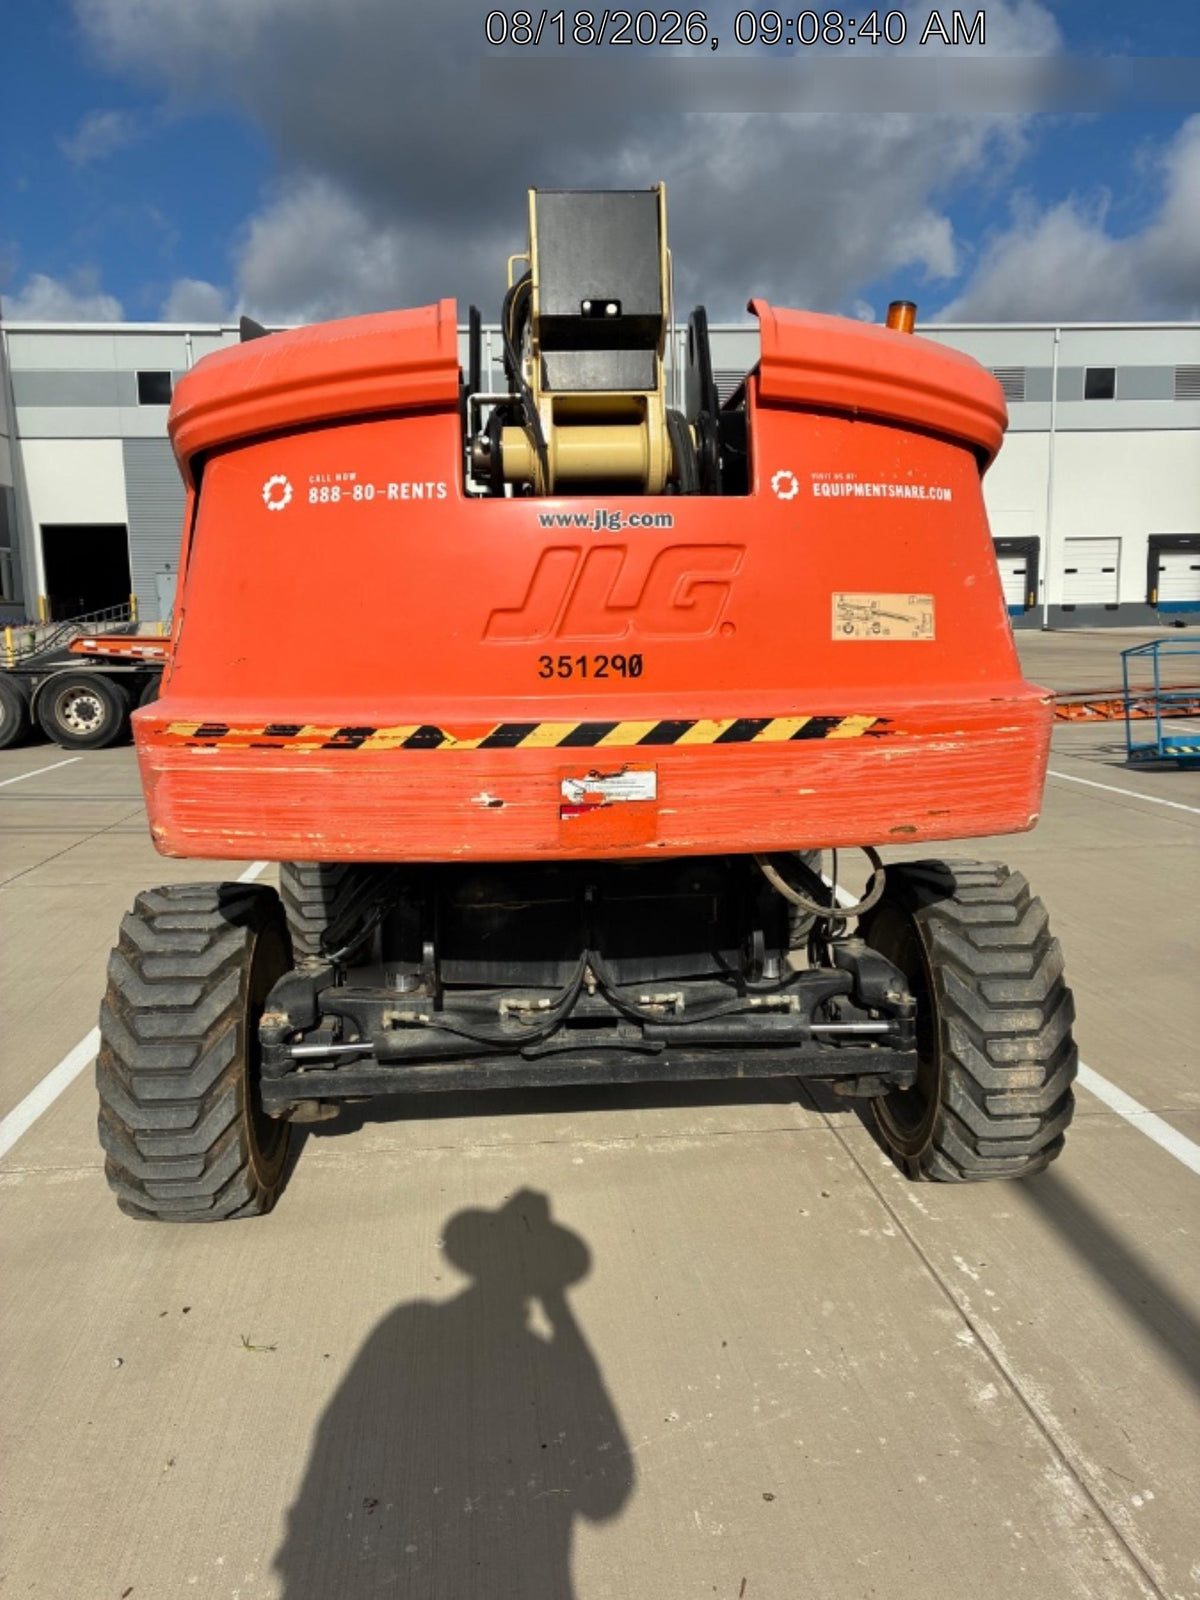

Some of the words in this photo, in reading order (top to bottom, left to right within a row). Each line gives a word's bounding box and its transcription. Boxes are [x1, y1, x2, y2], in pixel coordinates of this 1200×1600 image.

[309, 475, 332, 483] CALL
[335, 473, 357, 481] NOW
[308, 482, 447, 503] 888-80-RENTS
[813, 482, 952, 501] EQUIPMENTSHARE.COM
[539, 510, 674, 530] www.jlg.com
[538, 654, 644, 678] 351290
